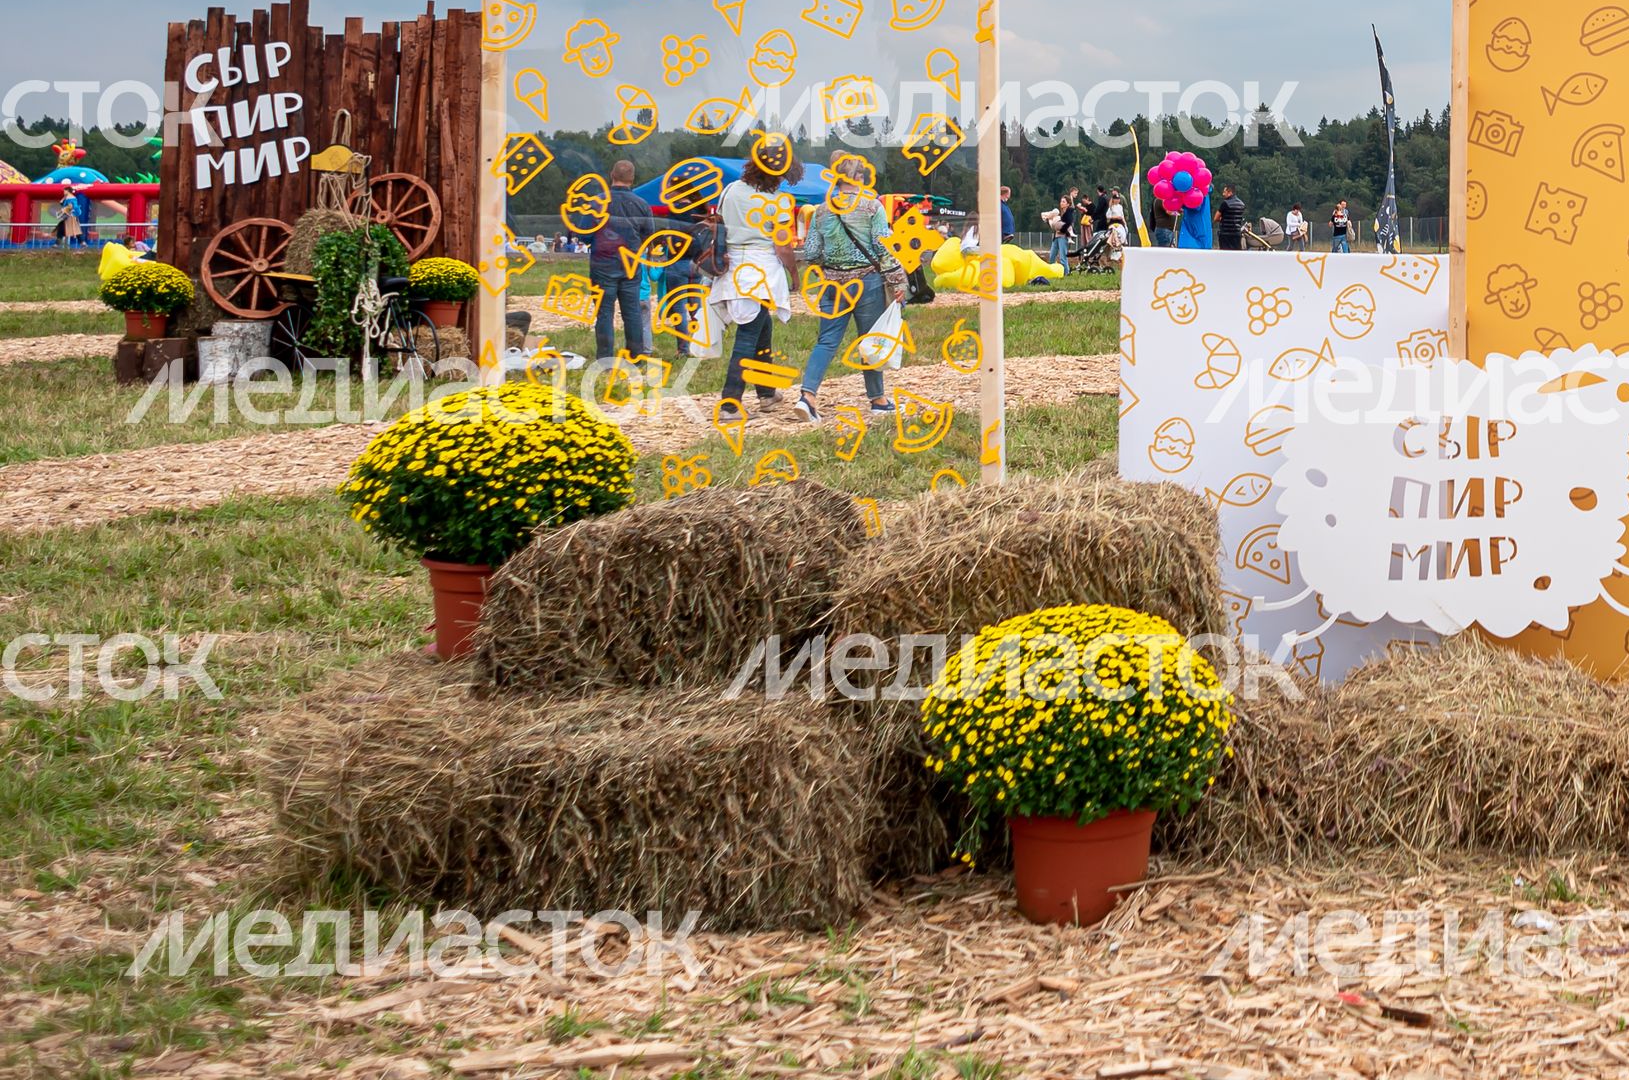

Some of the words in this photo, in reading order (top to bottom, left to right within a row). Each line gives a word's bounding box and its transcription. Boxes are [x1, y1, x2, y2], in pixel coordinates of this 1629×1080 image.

[185, 42, 292, 94] СЫР
[191, 92, 303, 147] ПИР
[196, 136, 311, 190] МИР
[1393, 415, 1517, 460] СЫР
[1388, 476, 1523, 520] ПИР
[1388, 536, 1518, 581] МИР
